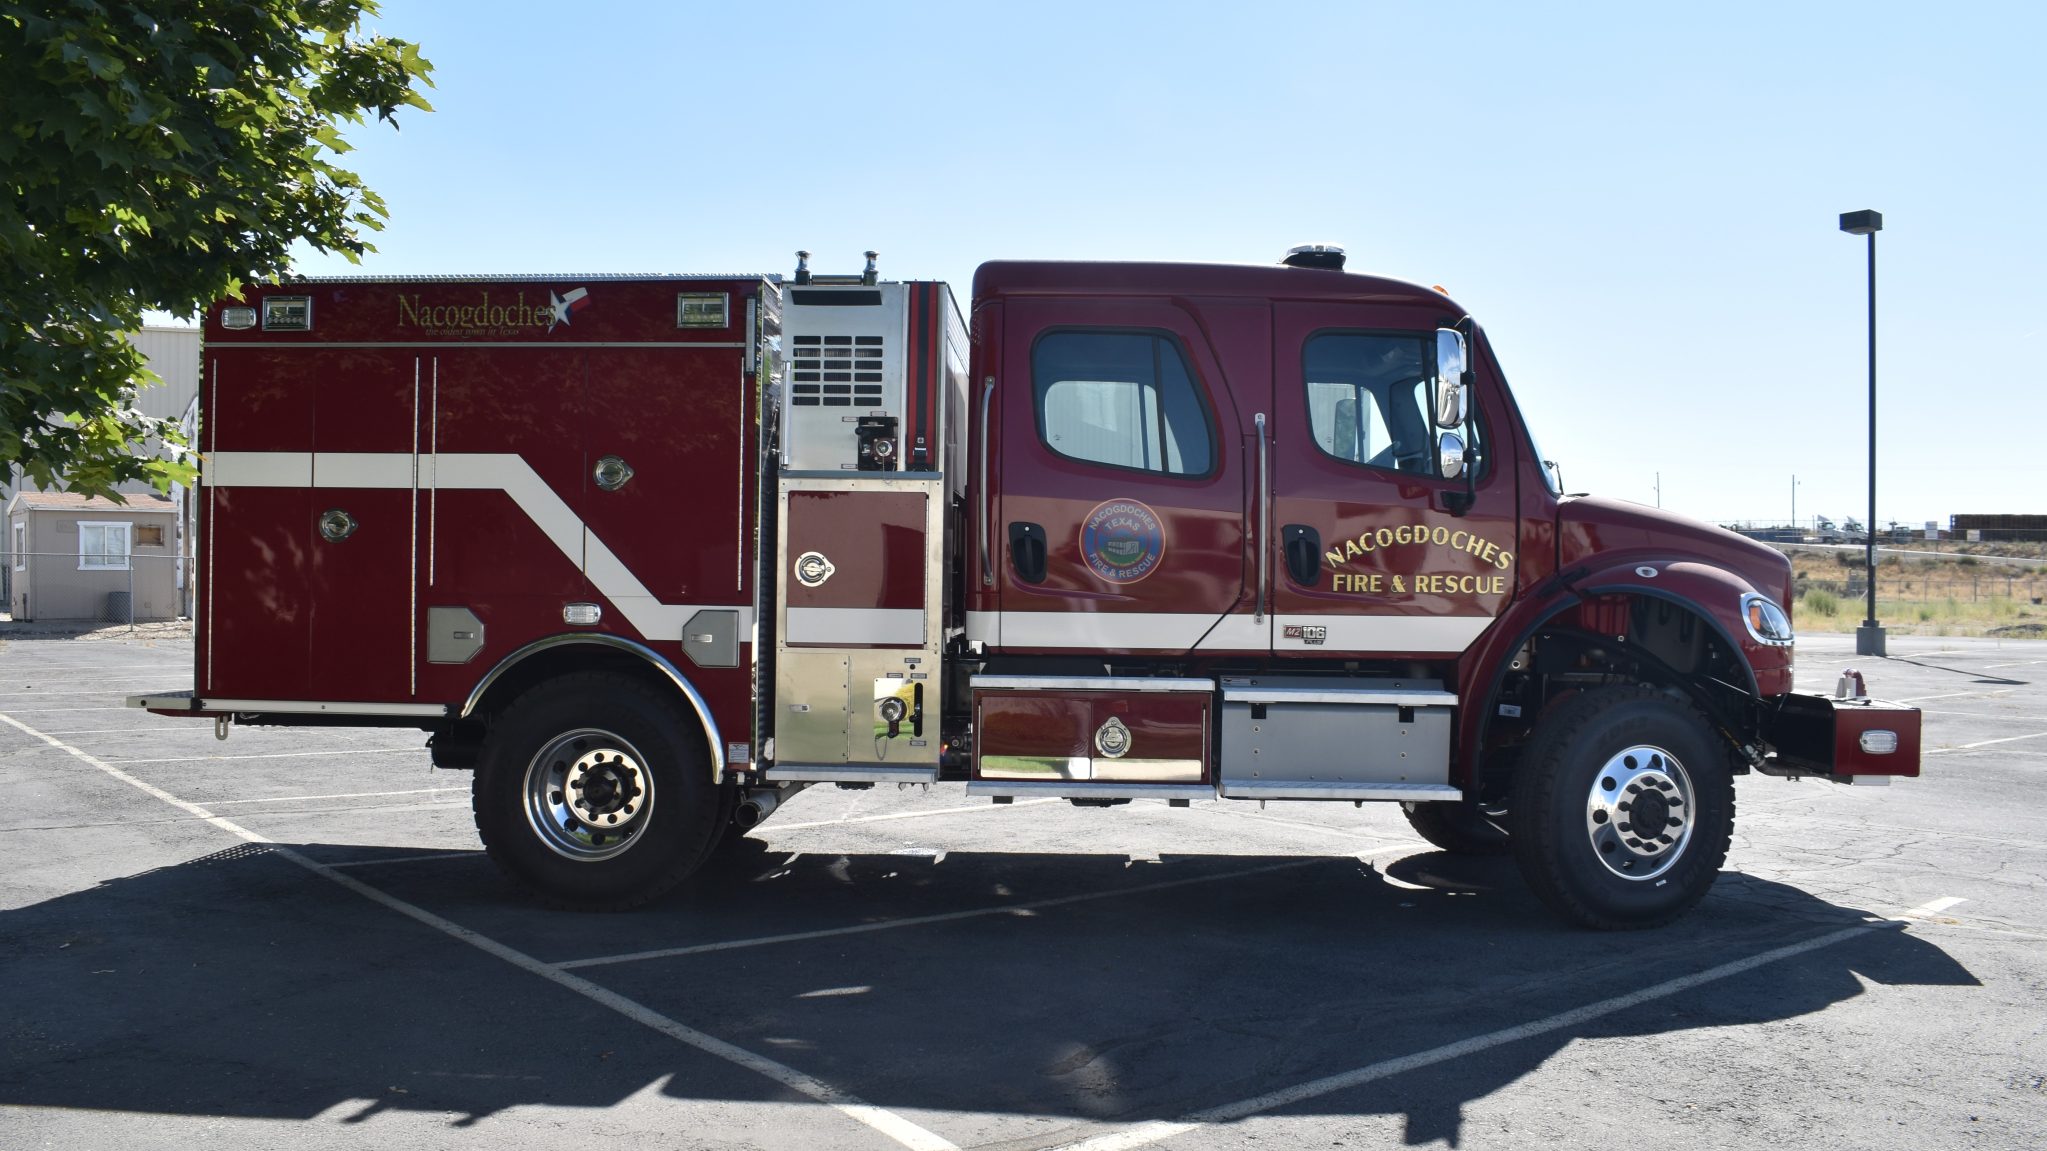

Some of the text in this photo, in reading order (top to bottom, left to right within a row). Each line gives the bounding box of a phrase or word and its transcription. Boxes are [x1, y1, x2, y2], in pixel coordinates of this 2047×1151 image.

[398, 292, 557, 328] Nacogdoches
[1089, 505, 1155, 530] NACOGDOCHES
[1104, 517, 1140, 531] TEXAS
[1325, 525, 1513, 570] NACOGDOCHES
[1089, 553, 1155, 578] FIRE & RESCUE
[1332, 574, 1505, 593] FIRE & RESCUE
